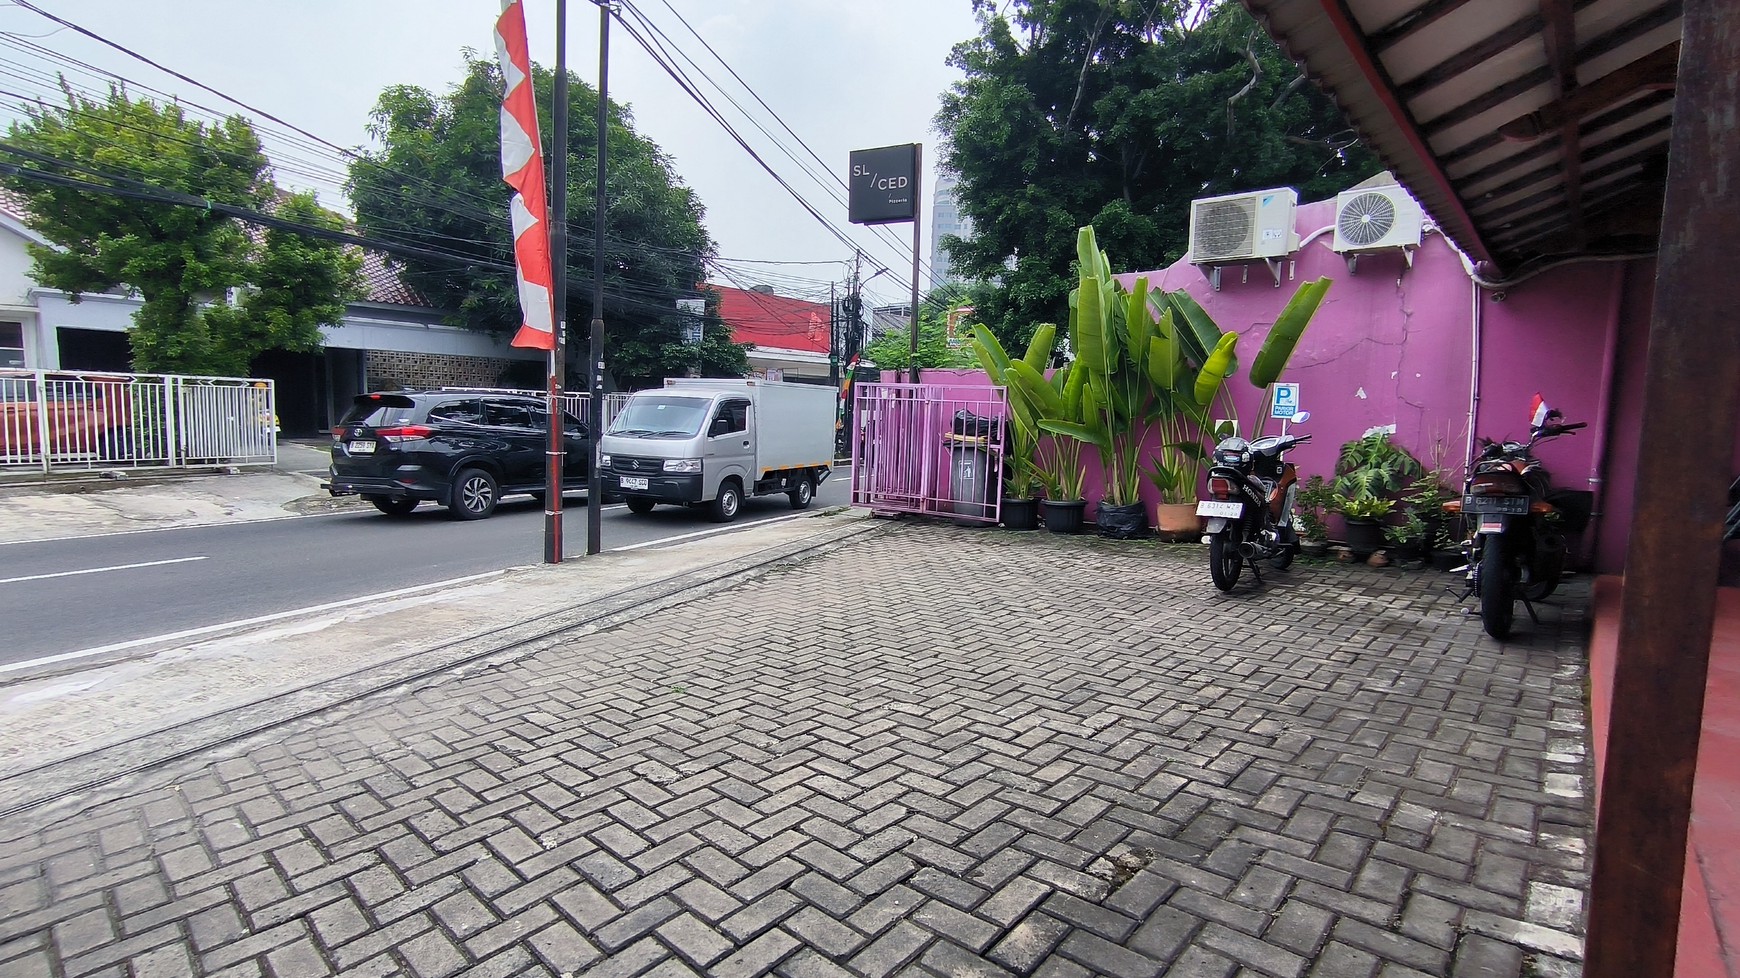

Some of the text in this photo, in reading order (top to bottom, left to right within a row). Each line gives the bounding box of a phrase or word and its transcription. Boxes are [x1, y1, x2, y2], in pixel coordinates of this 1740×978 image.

[1276, 387, 1292, 404] P
[1242, 484, 1262, 507] HONDA
[1465, 496, 1472, 505] B
